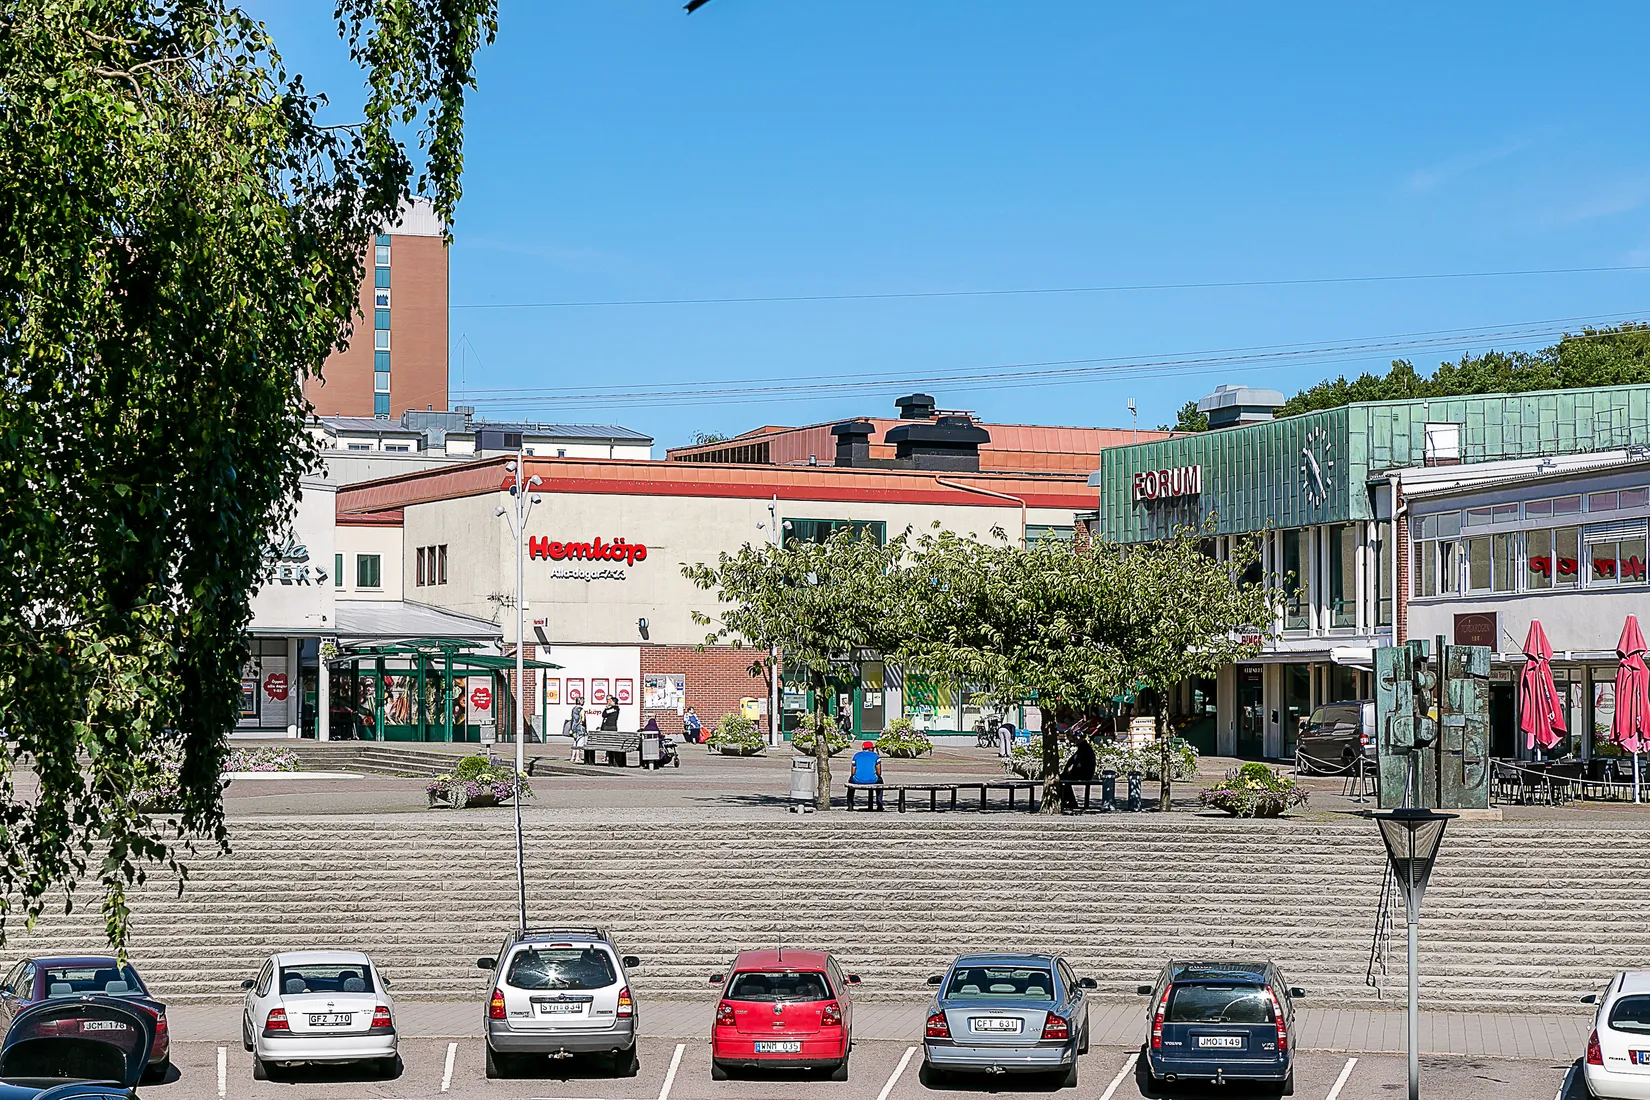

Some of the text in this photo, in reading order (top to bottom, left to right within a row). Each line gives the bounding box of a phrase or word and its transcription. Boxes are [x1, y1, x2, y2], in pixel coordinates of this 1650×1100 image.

[1134, 465, 1201, 500] FORUM
[529, 536, 647, 566] Hemköp
[310, 1014, 350, 1023] GFZ 710
[86, 1021, 103, 1030] JCM
[976, 1019, 1015, 1028] CFT 631
[761, 1041, 799, 1050] WNM 035
[1200, 1037, 1241, 1046] JMO 149
